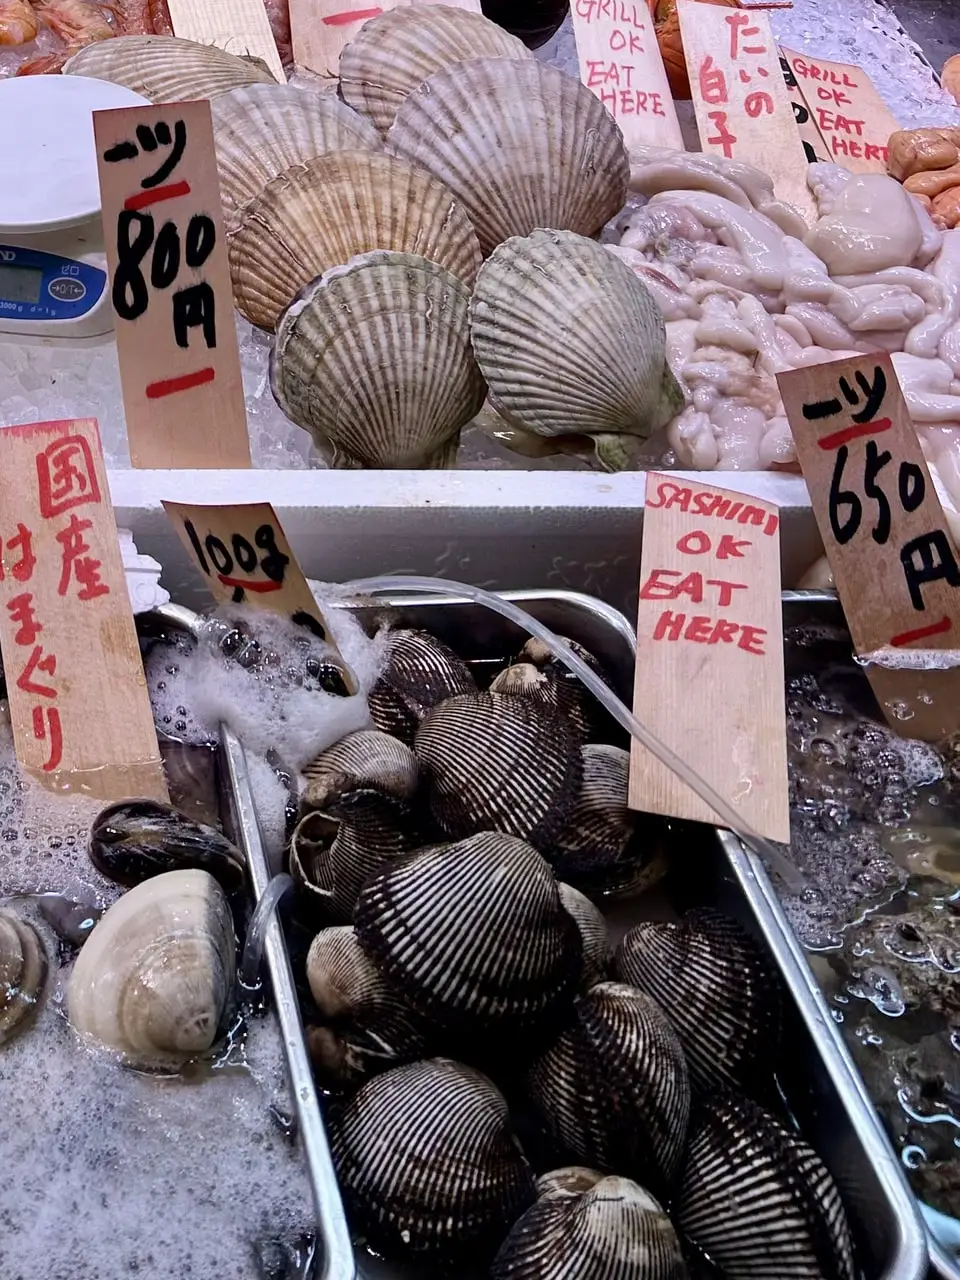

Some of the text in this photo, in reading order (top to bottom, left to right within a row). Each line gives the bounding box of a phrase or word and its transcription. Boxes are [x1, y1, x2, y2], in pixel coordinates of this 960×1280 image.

[609, 29, 645, 53] OK
[725, 13, 774, 119] たいの
[587, 60, 634, 88] EAT
[792, 57, 858, 88] GRILL
[112, 207, 216, 320] 800
[172, 282, 217, 349] 円
[36, 434, 110, 600] 国産
[645, 482, 779, 536] SASHIMI
[829, 440, 926, 545] 650
[184, 518, 290, 583] 100g
[676, 530, 753, 560] OK
[900, 529, 960, 611] 円
[640, 569, 749, 607] EAT
[652, 610, 768, 655] HERE
